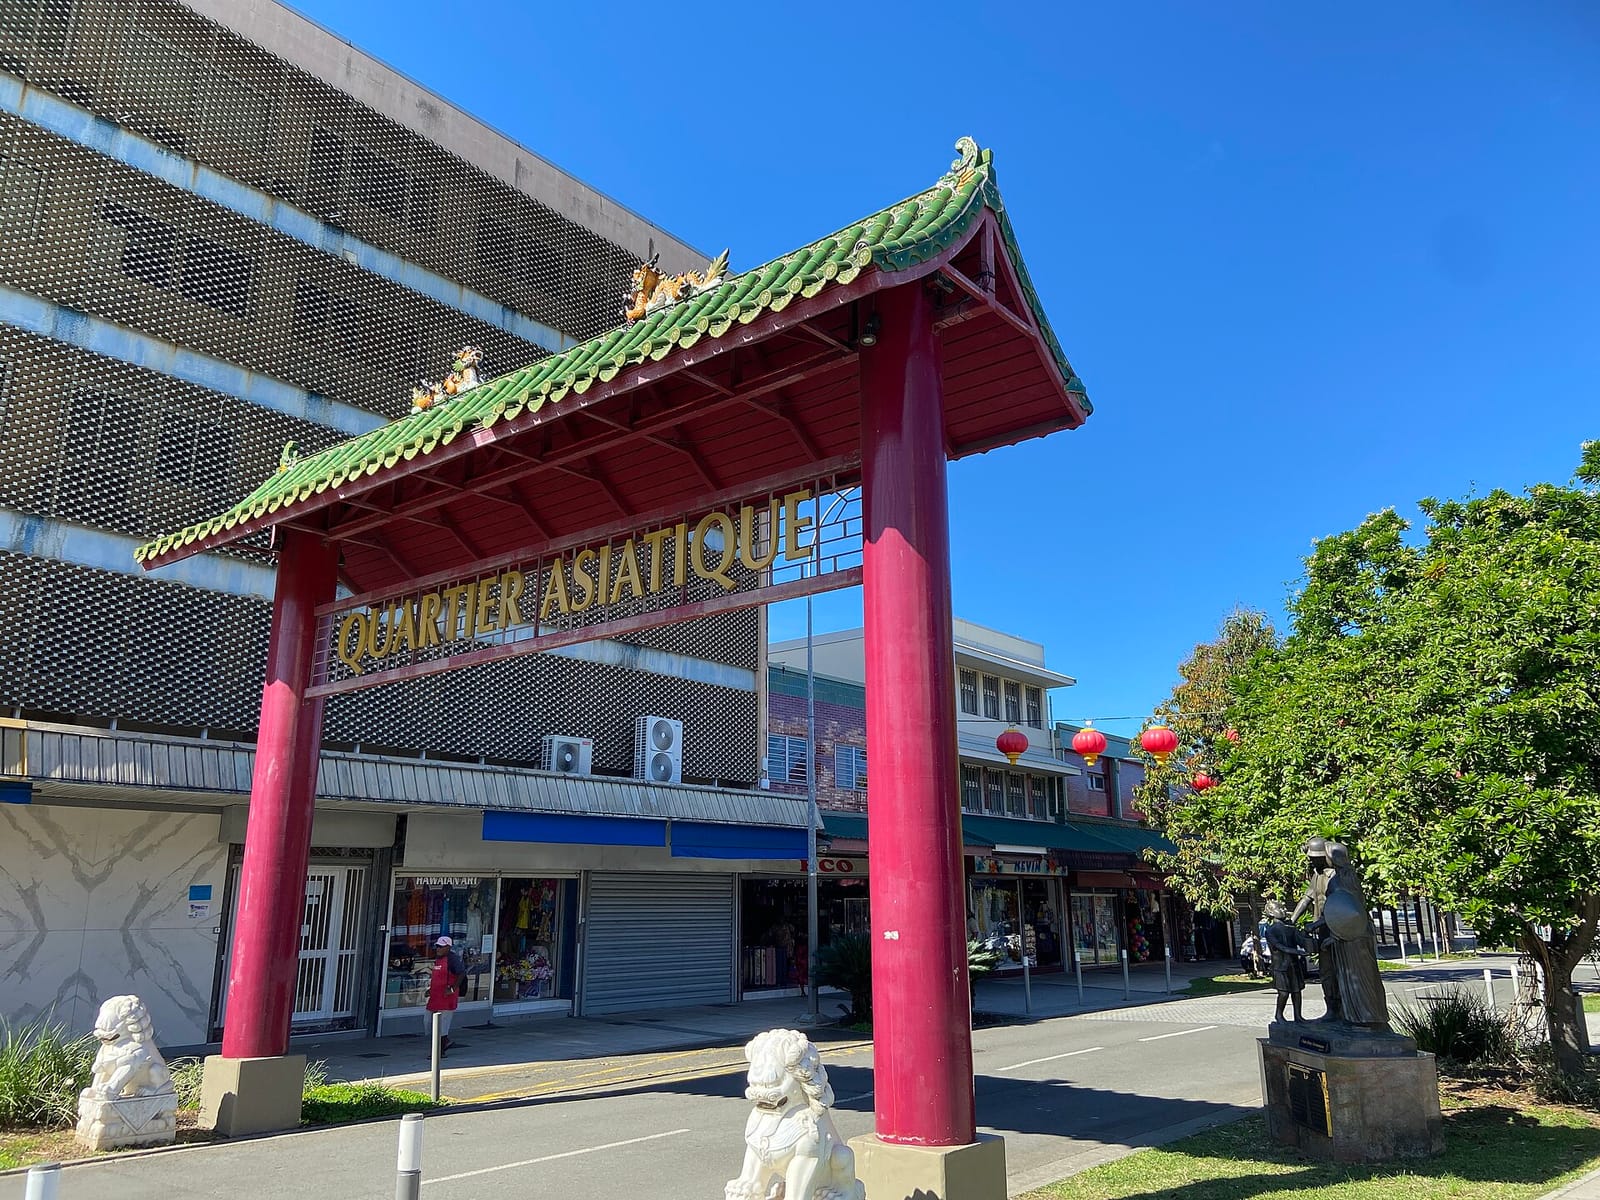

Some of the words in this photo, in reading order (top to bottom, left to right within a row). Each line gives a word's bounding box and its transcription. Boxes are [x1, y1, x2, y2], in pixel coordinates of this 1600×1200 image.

[338, 570, 525, 675] QUARTIER
[540, 488, 814, 619] ASIATIQUE
[1014, 860, 1041, 873] KEVIN
